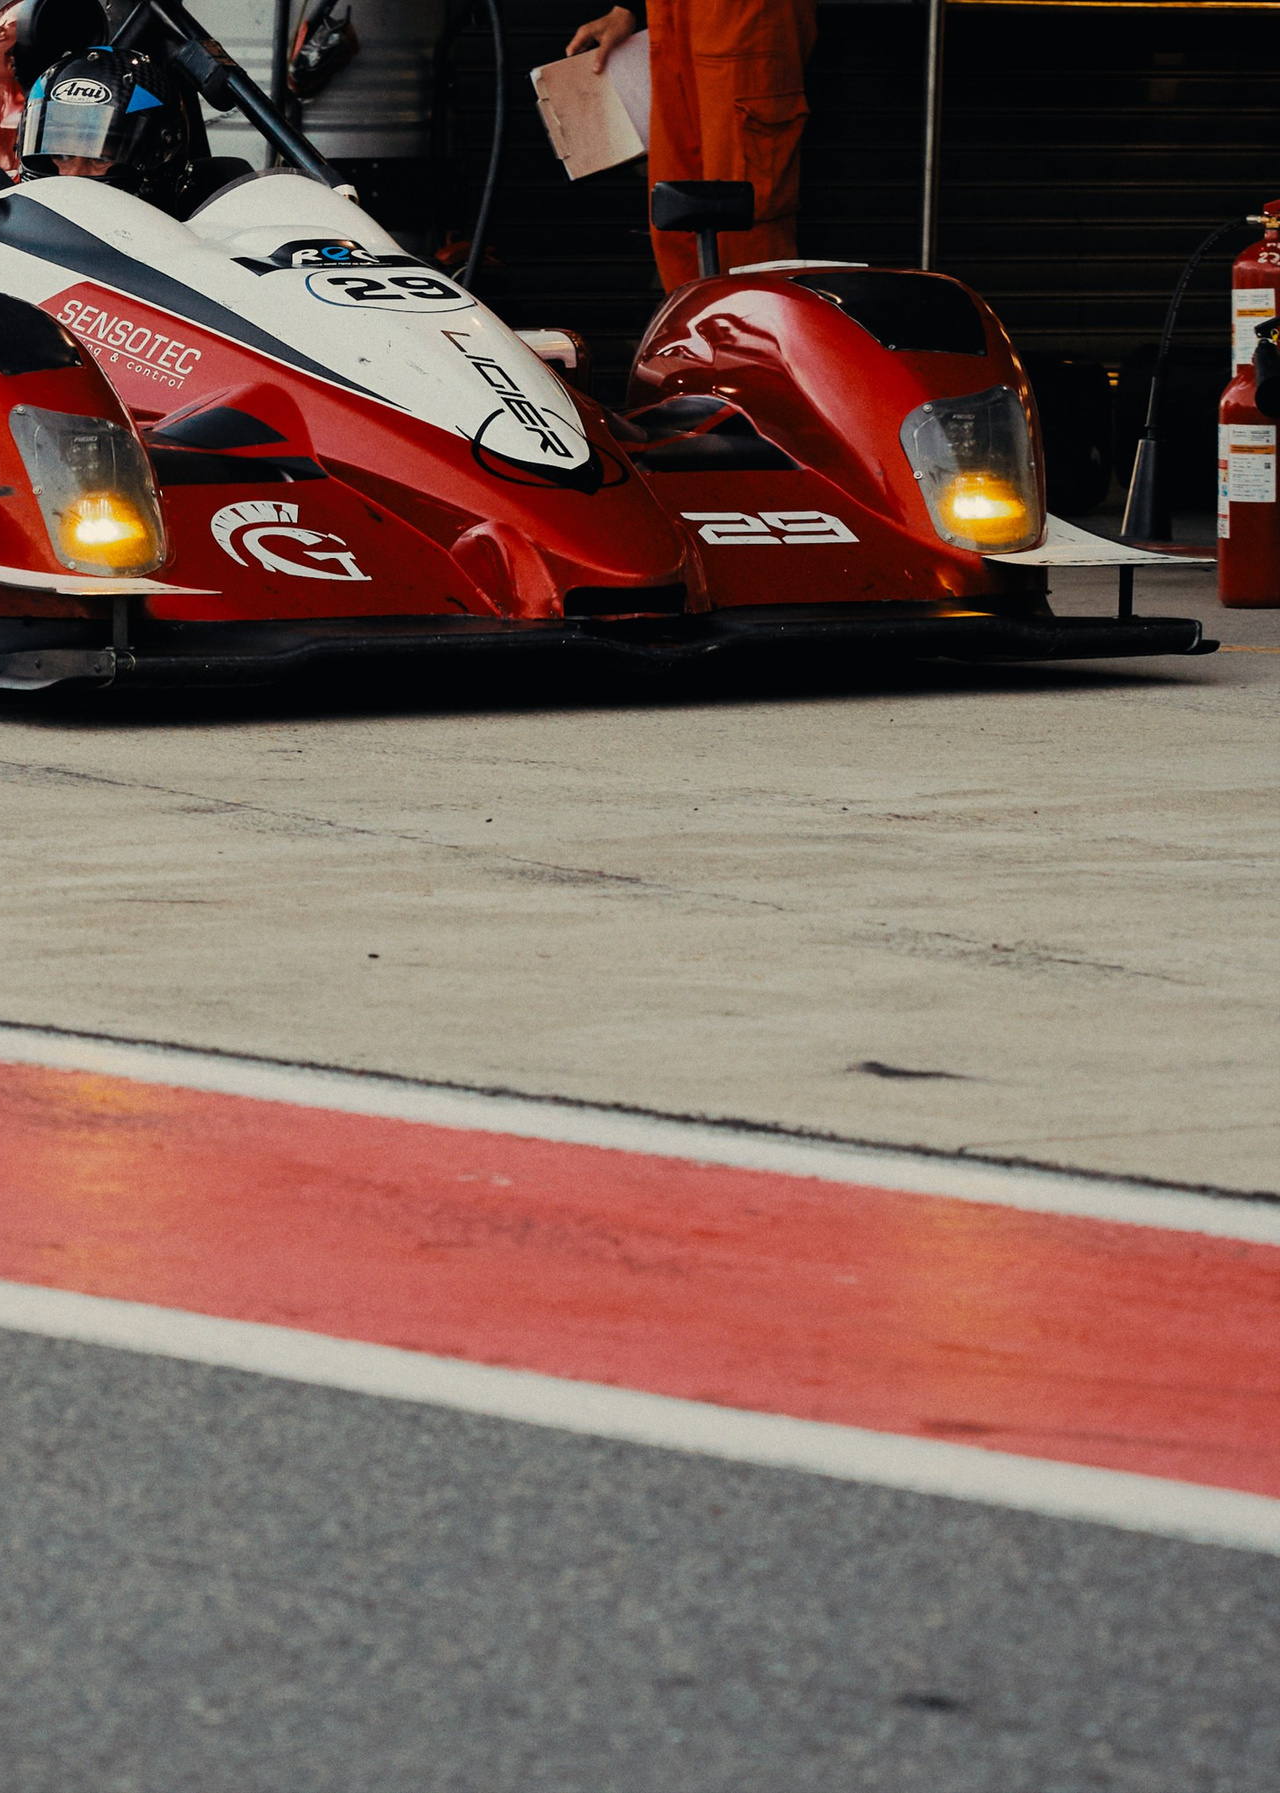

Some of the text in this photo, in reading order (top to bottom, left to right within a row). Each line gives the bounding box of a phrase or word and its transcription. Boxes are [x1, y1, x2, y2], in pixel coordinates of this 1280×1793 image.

[56, 82, 104, 99] Arai
[327, 276, 462, 301] 29
[57, 299, 202, 375] SENSOTEC
[109, 352, 119, 364] &
[126, 360, 184, 390] control
[680, 510, 860, 545] 29
